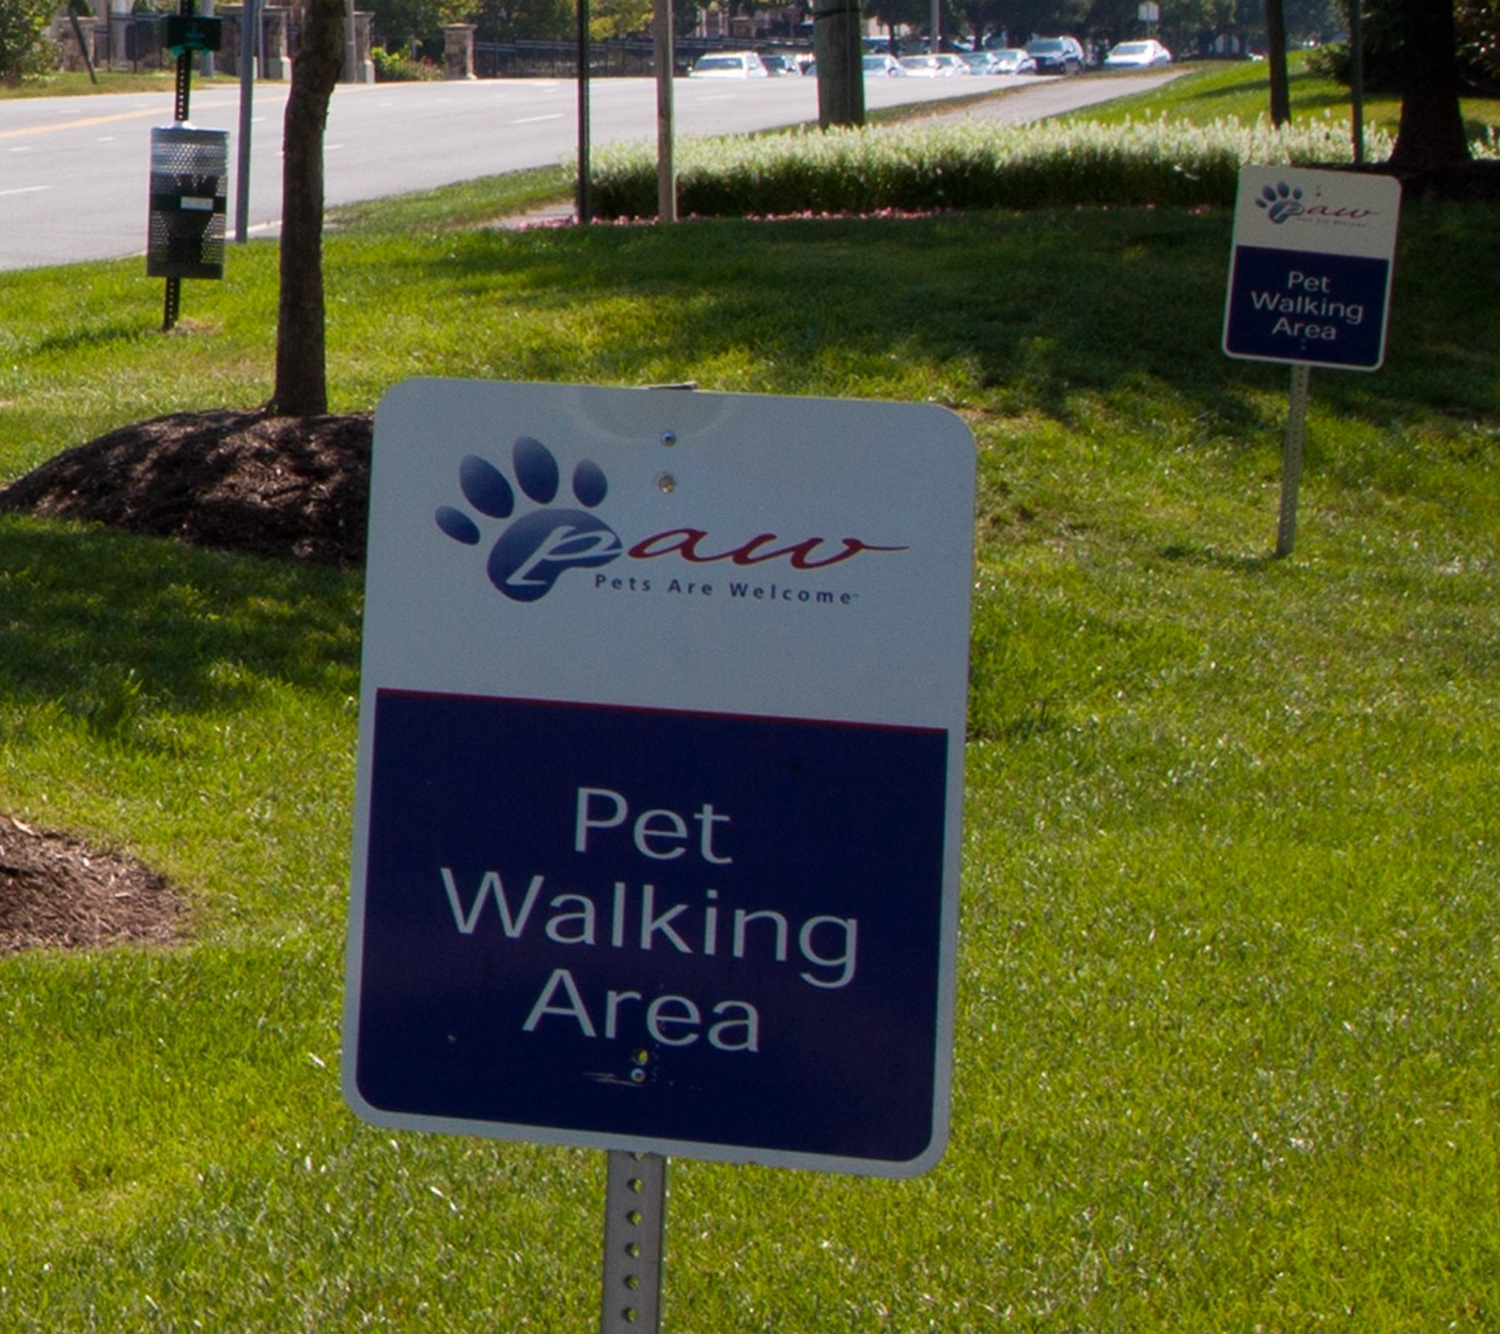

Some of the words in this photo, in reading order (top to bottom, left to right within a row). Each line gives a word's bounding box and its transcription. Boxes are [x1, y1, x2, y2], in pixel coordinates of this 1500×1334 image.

[1287, 271, 1331, 293] Pet
[1251, 291, 1364, 324] Walking
[1271, 317, 1337, 340] Area
[595, 573, 652, 592] Pets
[667, 578, 713, 596] Are
[575, 787, 732, 865] Pet
[441, 867, 858, 990] Walking
[522, 967, 760, 1053] Area
